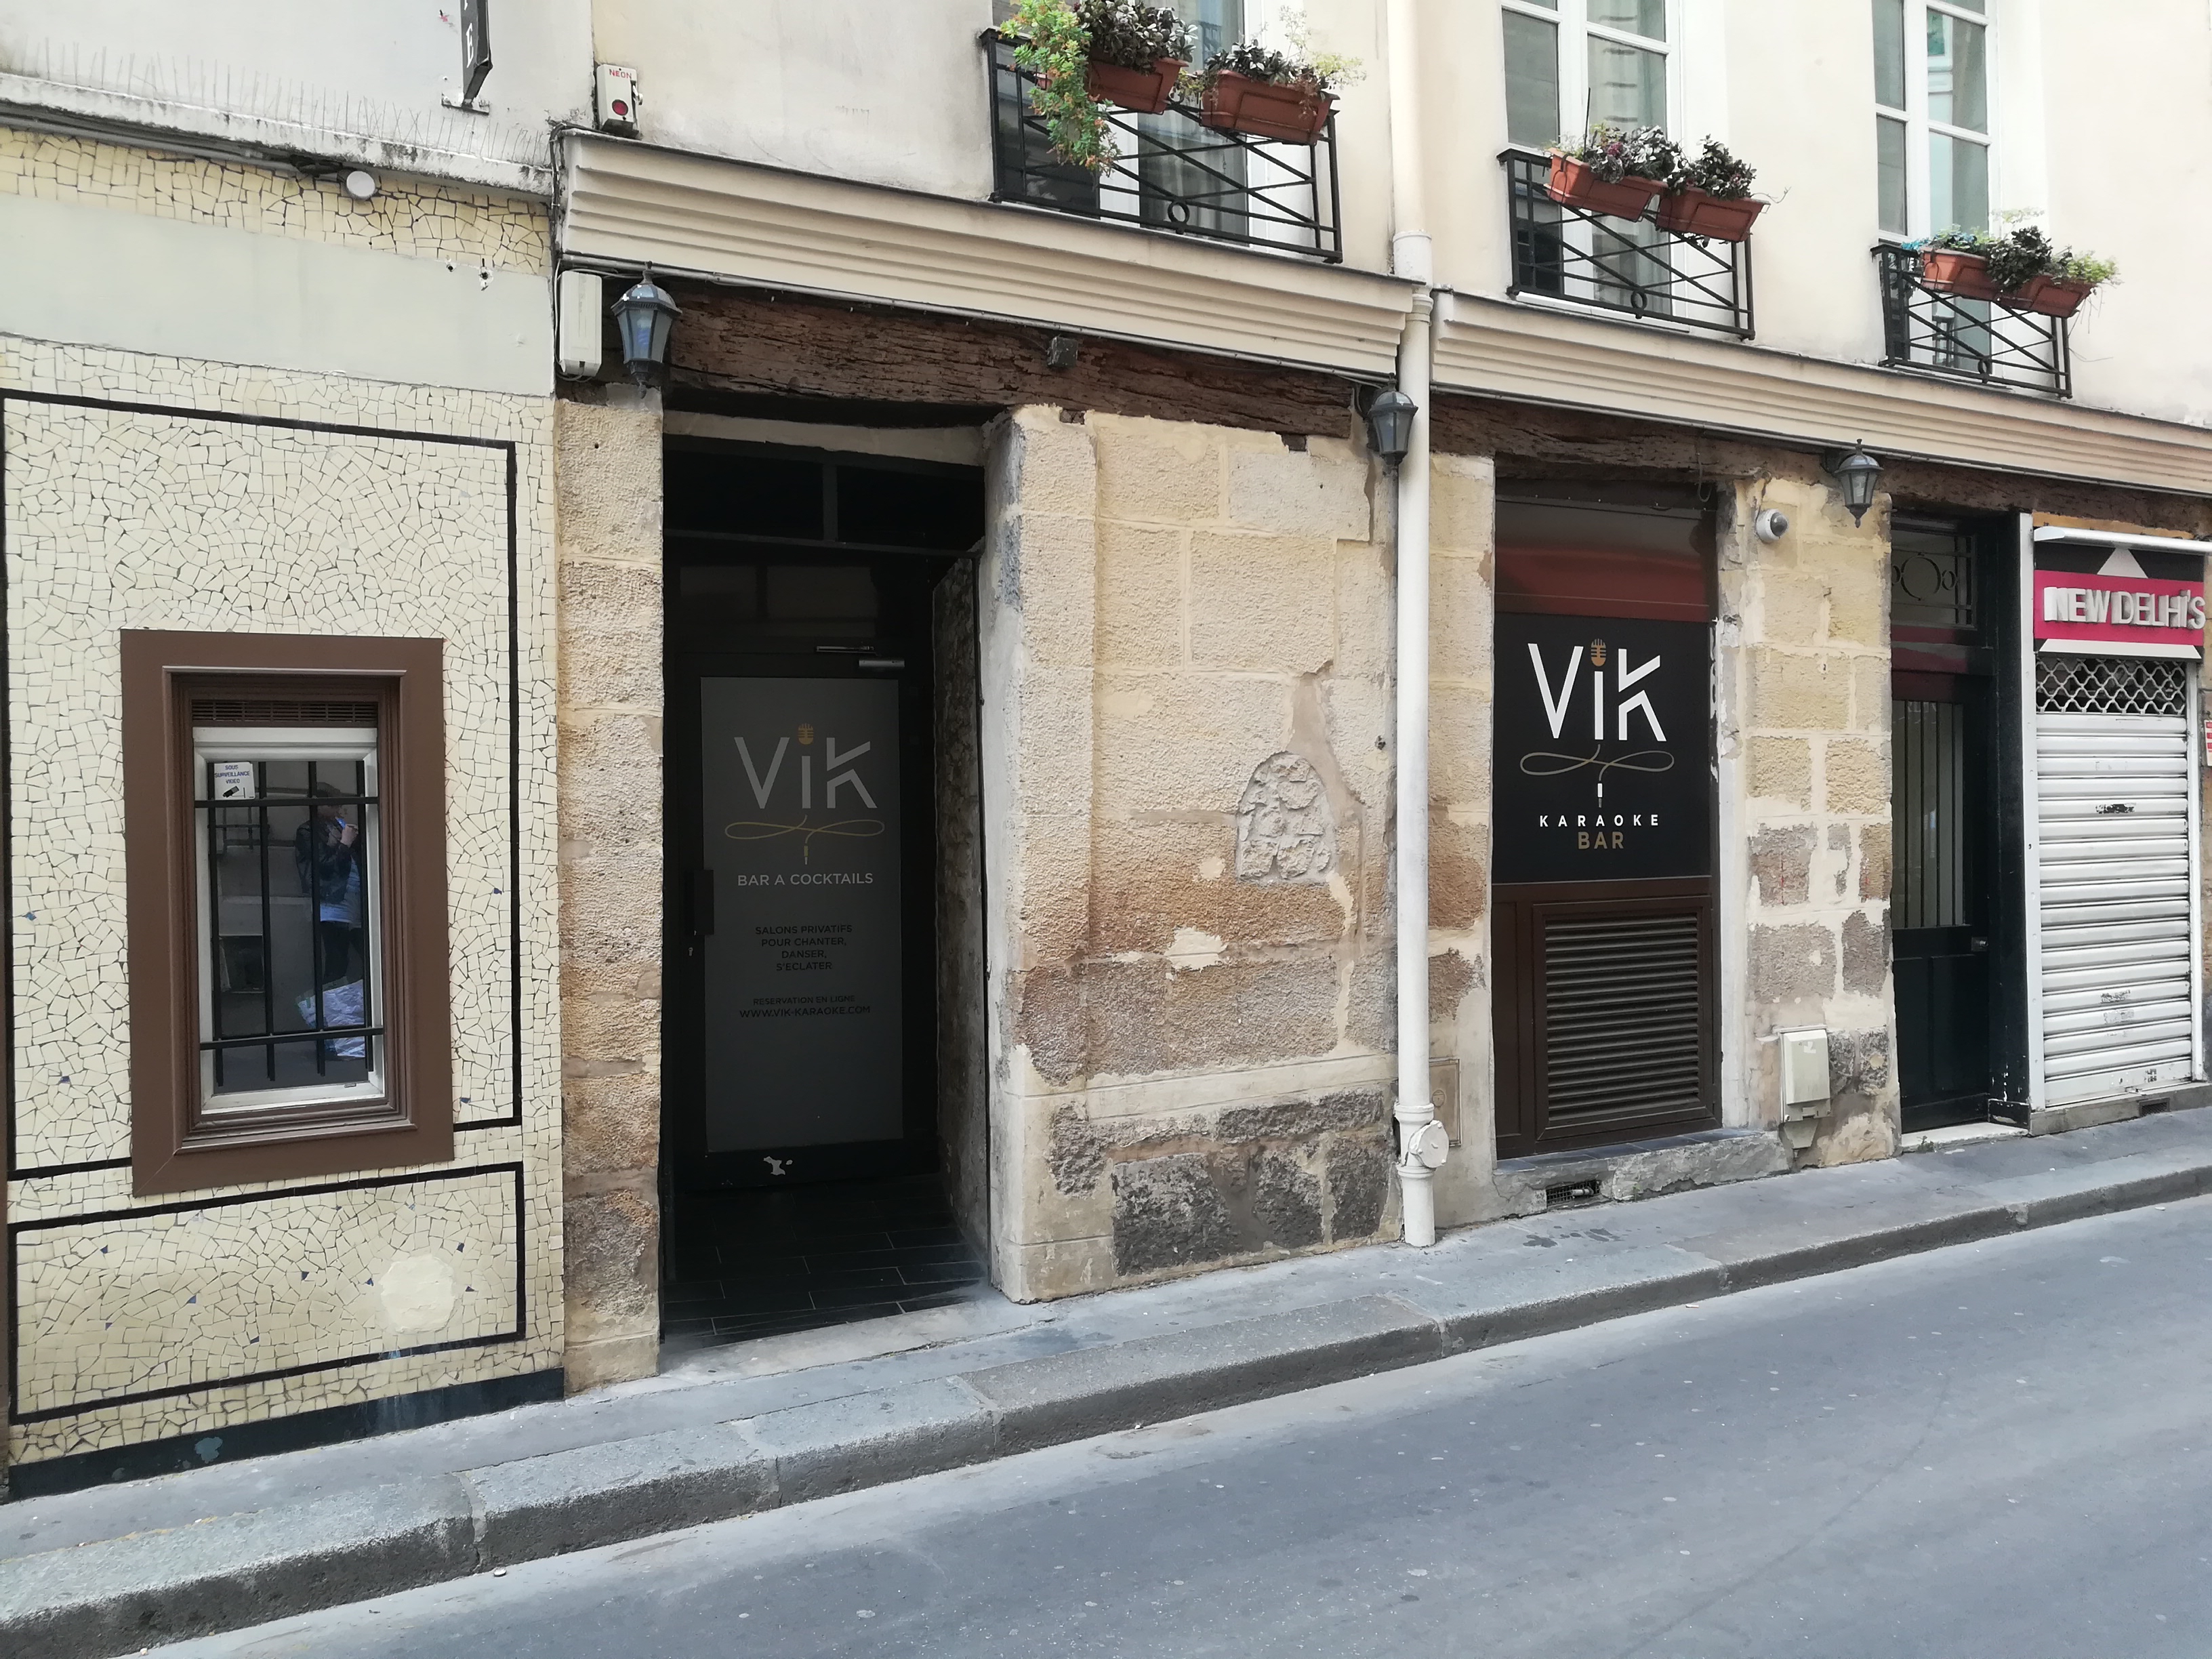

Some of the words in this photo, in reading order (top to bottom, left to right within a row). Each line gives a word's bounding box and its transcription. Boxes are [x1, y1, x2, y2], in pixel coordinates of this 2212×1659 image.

[609, 68, 632, 79] NEON
[2043, 587, 2111, 623] NEW
[2111, 589, 2207, 630] DELHI'S
[1540, 815, 1658, 827] KARAOKE
[1578, 832, 1624, 849] BAR
[738, 875, 770, 886] BAR
[775, 874, 785, 885] A
[790, 873, 874, 885] COCKTAILS
[755, 926, 798, 935] SALONS
[801, 925, 853, 934] PRIVATIFS
[761, 939, 791, 947] POUR
[794, 937, 846, 947] CHANTER,
[781, 950, 827, 959] DANSER,
[776, 962, 832, 971] S'ECLATER
[753, 997, 813, 1006] RESERVATION
[830, 995, 855, 1003] LIGNE
[739, 1006, 871, 1018] WWW.VIK-KARAOKE.COM
